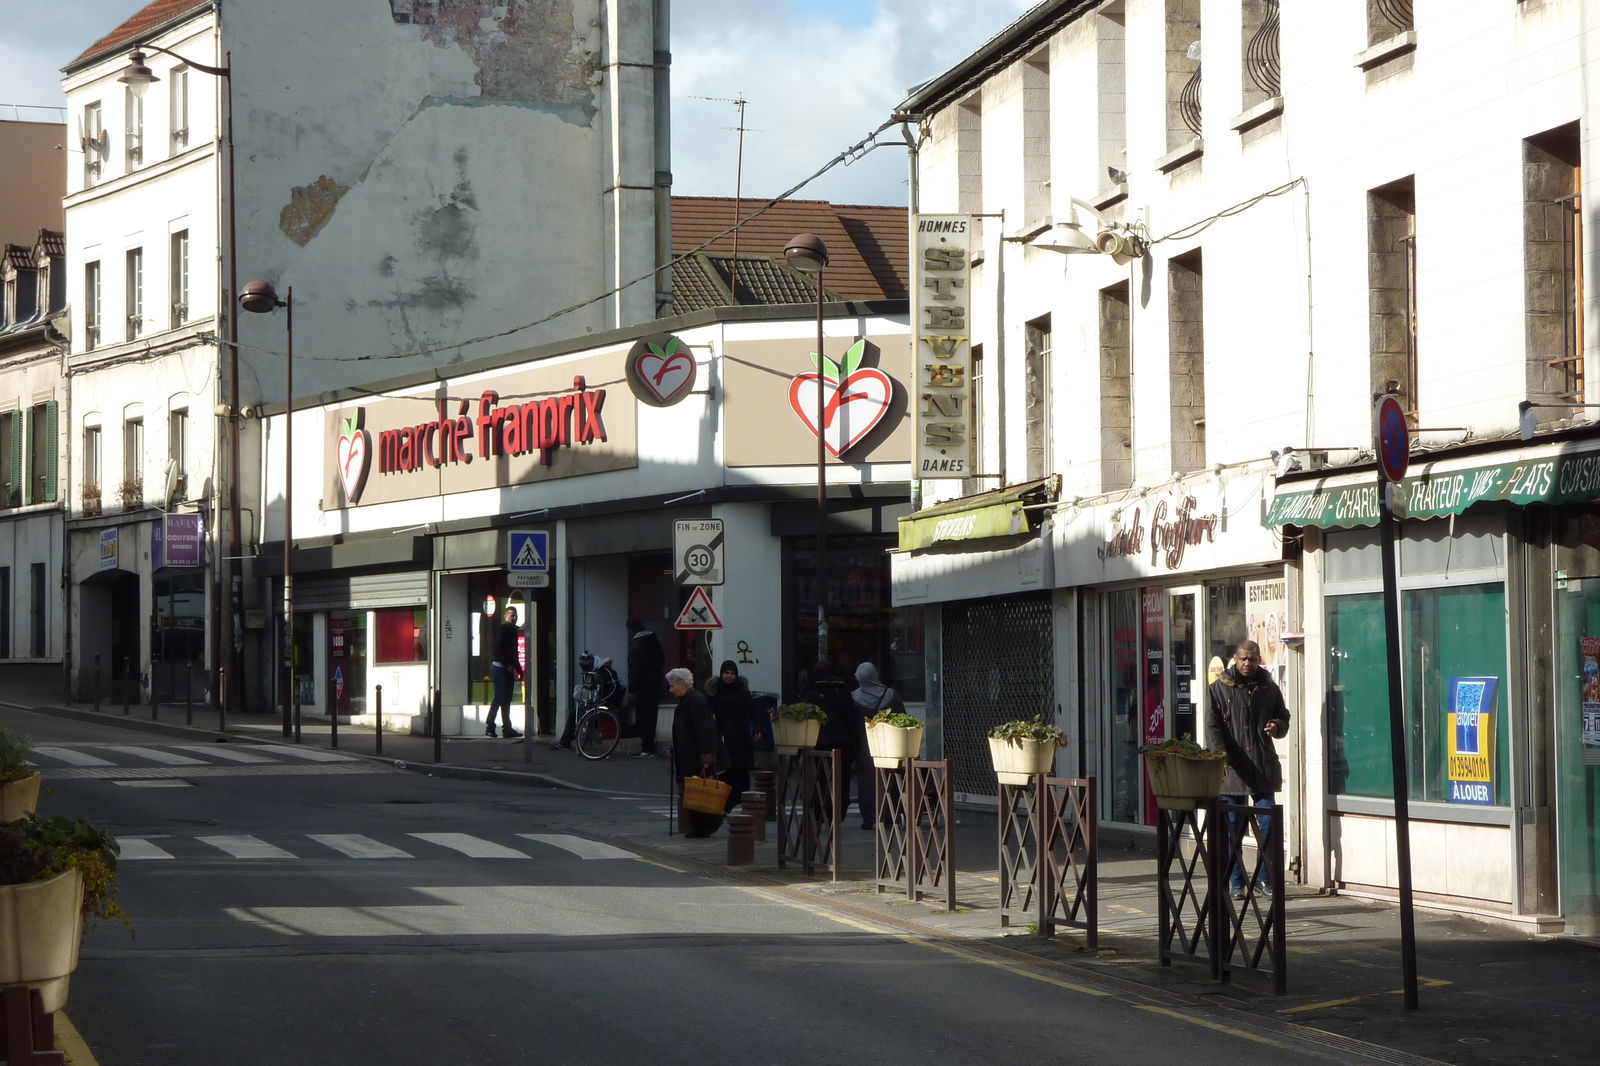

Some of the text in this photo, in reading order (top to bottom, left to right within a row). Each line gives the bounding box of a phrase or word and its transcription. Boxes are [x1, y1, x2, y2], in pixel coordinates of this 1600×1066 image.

[918, 220, 967, 233] HOMMES
[921, 247, 968, 446] STEVENS
[379, 376, 606, 475] marché franprix
[922, 459, 964, 472] DAMES
[1409, 475, 1464, 511] TRAITEUR
[1468, 468, 1501, 501] VINS
[1502, 462, 1553, 499] PLATS
[700, 523, 721, 531] ZONE
[690, 553, 709, 567] 30
[1453, 781, 1489, 801] À LOUER
